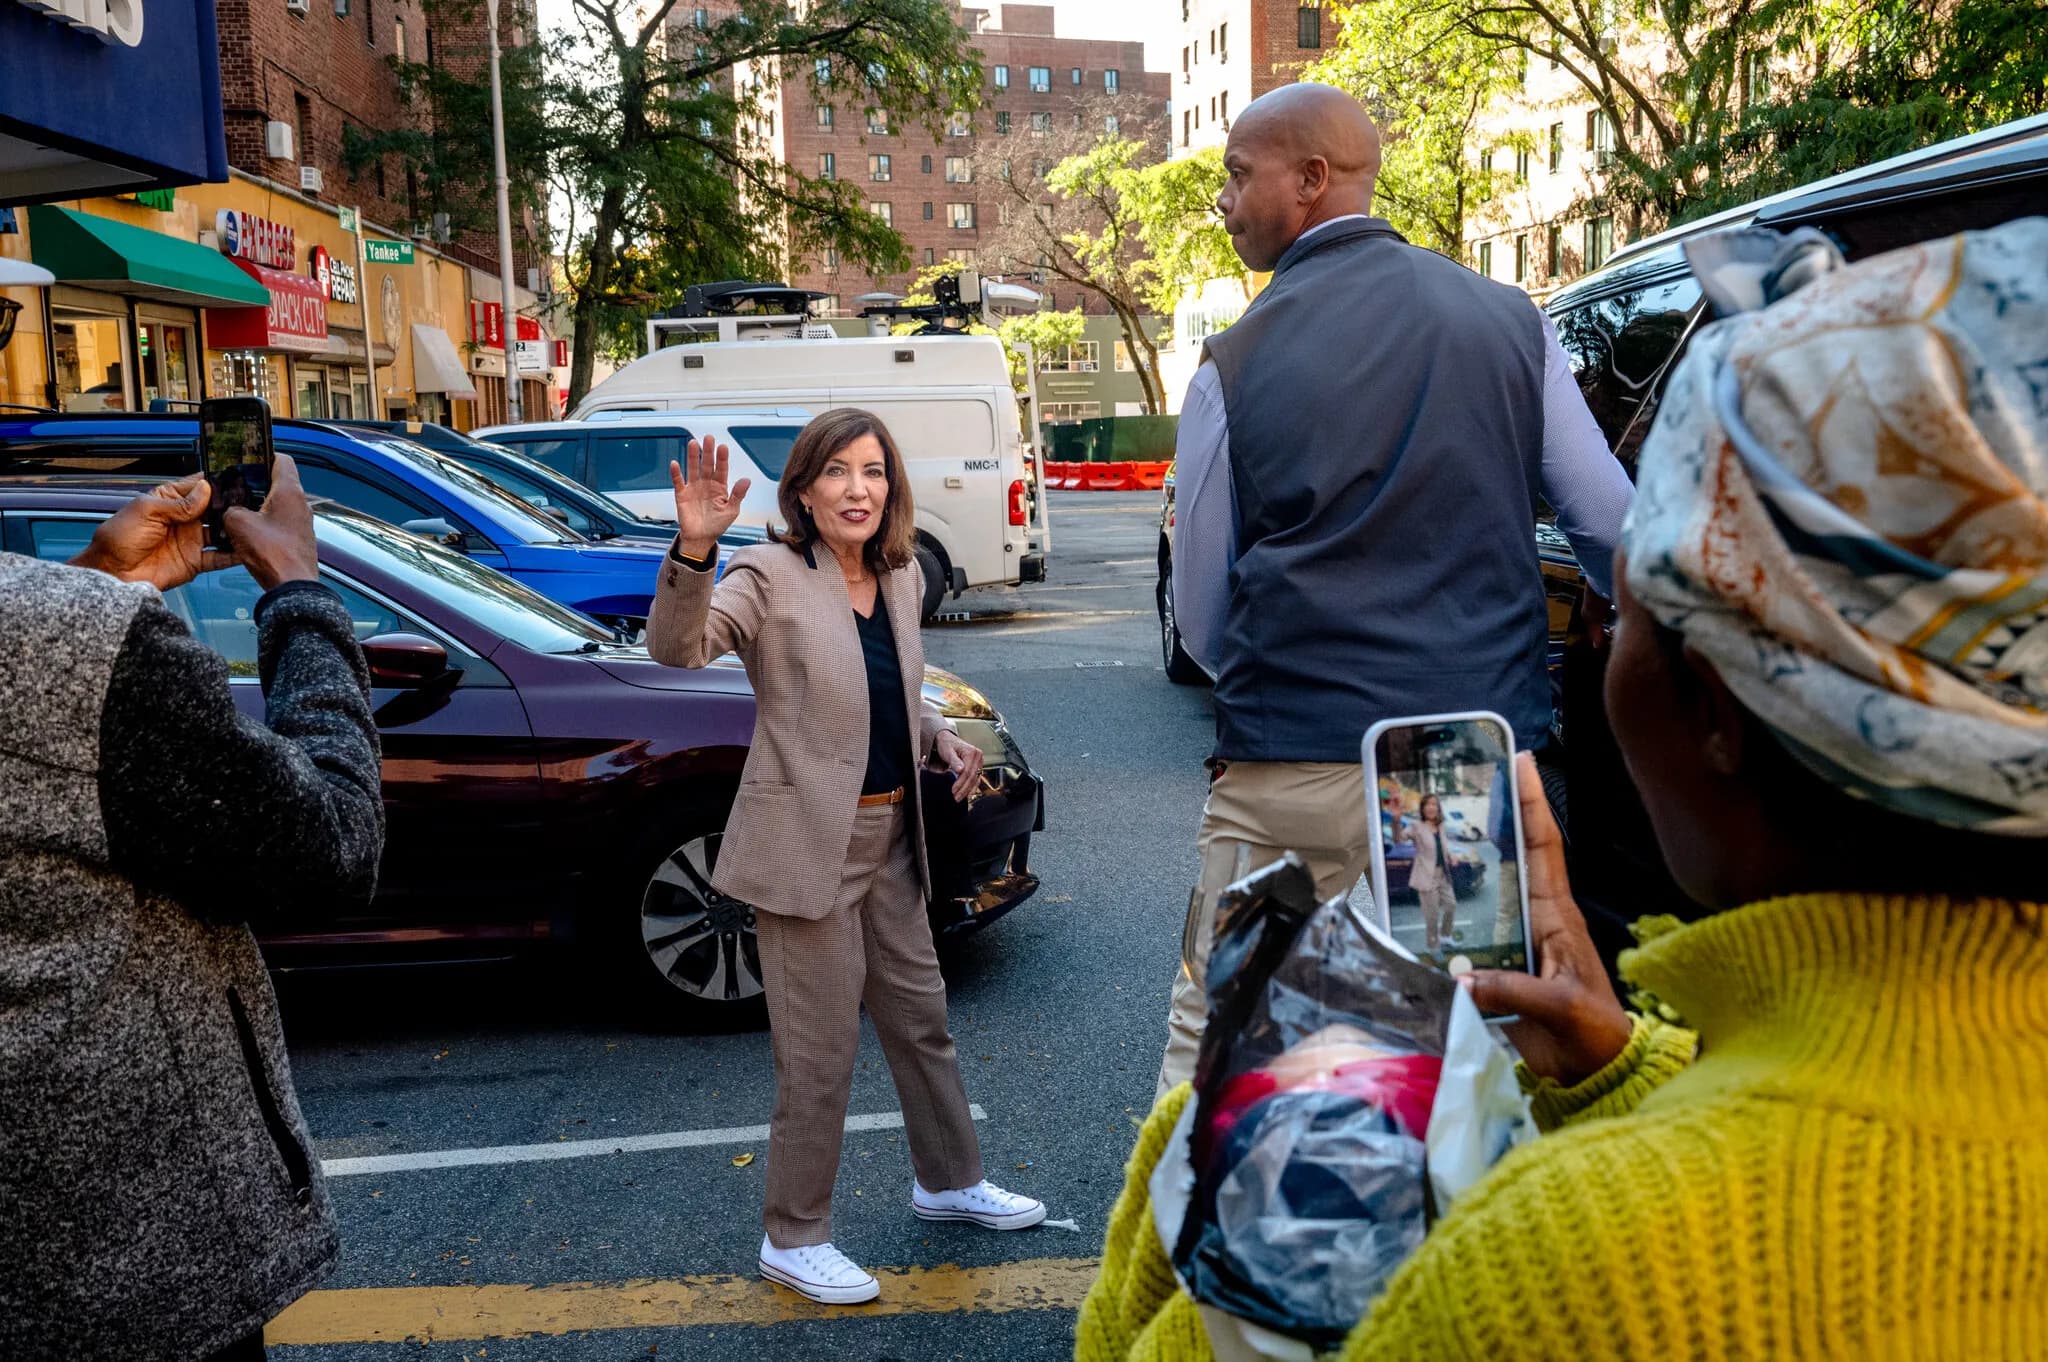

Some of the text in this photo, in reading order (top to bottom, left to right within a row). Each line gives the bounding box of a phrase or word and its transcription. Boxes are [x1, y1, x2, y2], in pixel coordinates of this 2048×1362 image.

[241, 211, 296, 270] EXPRESS
[368, 242, 399, 261] Yankee
[331, 275, 357, 304] REPAIR
[268, 288, 326, 335] SNACK CITY
[964, 460, 999, 471] NMC-1
